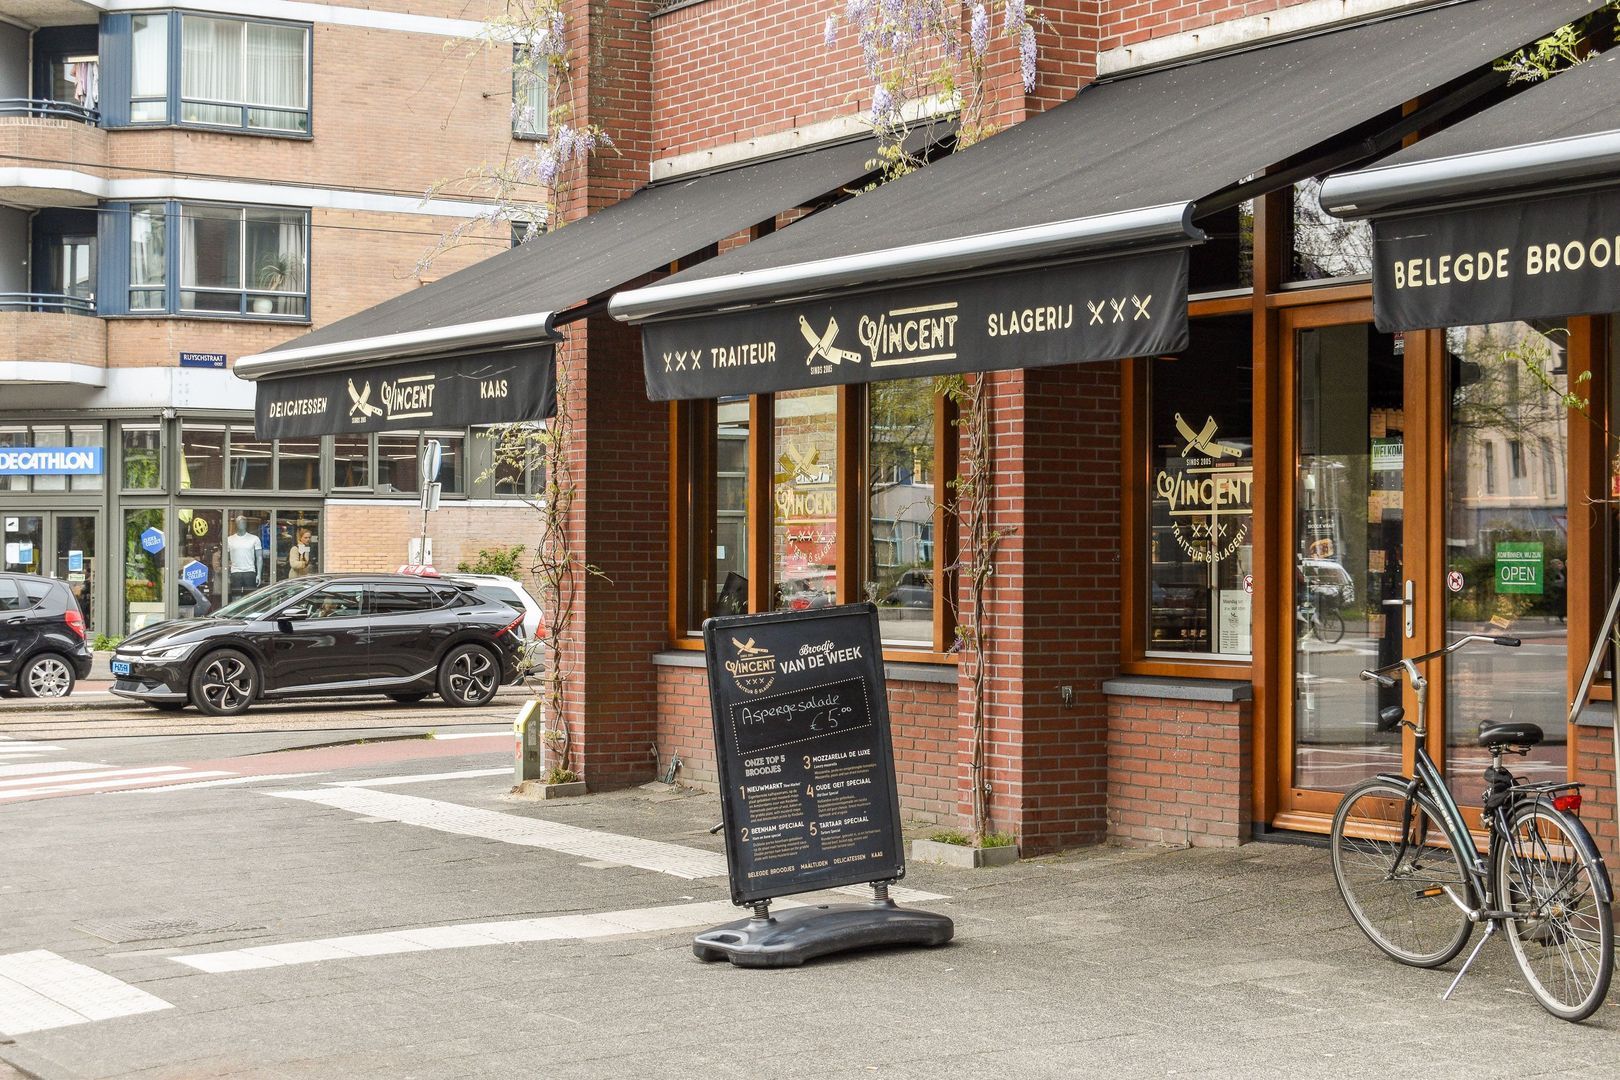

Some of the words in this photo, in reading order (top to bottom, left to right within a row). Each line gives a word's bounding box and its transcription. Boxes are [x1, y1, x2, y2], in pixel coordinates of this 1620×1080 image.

[1394, 248, 1509, 290] BELEGDE
[988, 304, 1073, 337] SLAGERIJ
[858, 314, 958, 362] VINCENT
[711, 342, 776, 368] TRAITEUR
[810, 366, 822, 374] SINDS
[381, 381, 435, 416] VINCENT
[480, 380, 508, 399] KAAS
[269, 397, 328, 418] DELICATESSEN
[0, 452, 94, 470] DECATHLON
[1374, 445, 1402, 458] WELKOM
[1171, 521, 1203, 562] TRAITEUR
[1206, 551, 1212, 564] &
[1214, 523, 1248, 562] SLAGERIJ
[1502, 566, 1535, 581] OPEN
[799, 640, 835, 656] Broodje
[780, 659, 806, 674] VAN
[808, 654, 825, 669] DE
[826, 646, 862, 665] WEEK
[745, 757, 764, 767] ONZE
[765, 755, 779, 764] TOP
[803, 755, 811, 769] 3
[813, 752, 847, 762] MOZZARELLA
[745, 765, 781, 777] BROODJES
[740, 786, 745, 800] 1
[747, 782, 783, 792] NIEUWMARKT
[806, 784, 814, 798] 4
[846, 778, 871, 787] SPECIAAL
[741, 827, 750, 842] 2
[751, 825, 777, 834] BEENHAM
[778, 821, 804, 830] SPECIAAL
[809, 821, 817, 836] 5
[819, 820, 842, 828] TARTAAR
[844, 816, 869, 825] SPECIAAL
[748, 870, 769, 878] BELEGDE
[770, 866, 795, 874] BROODJES
[834, 854, 866, 864] DELICATESSEN
